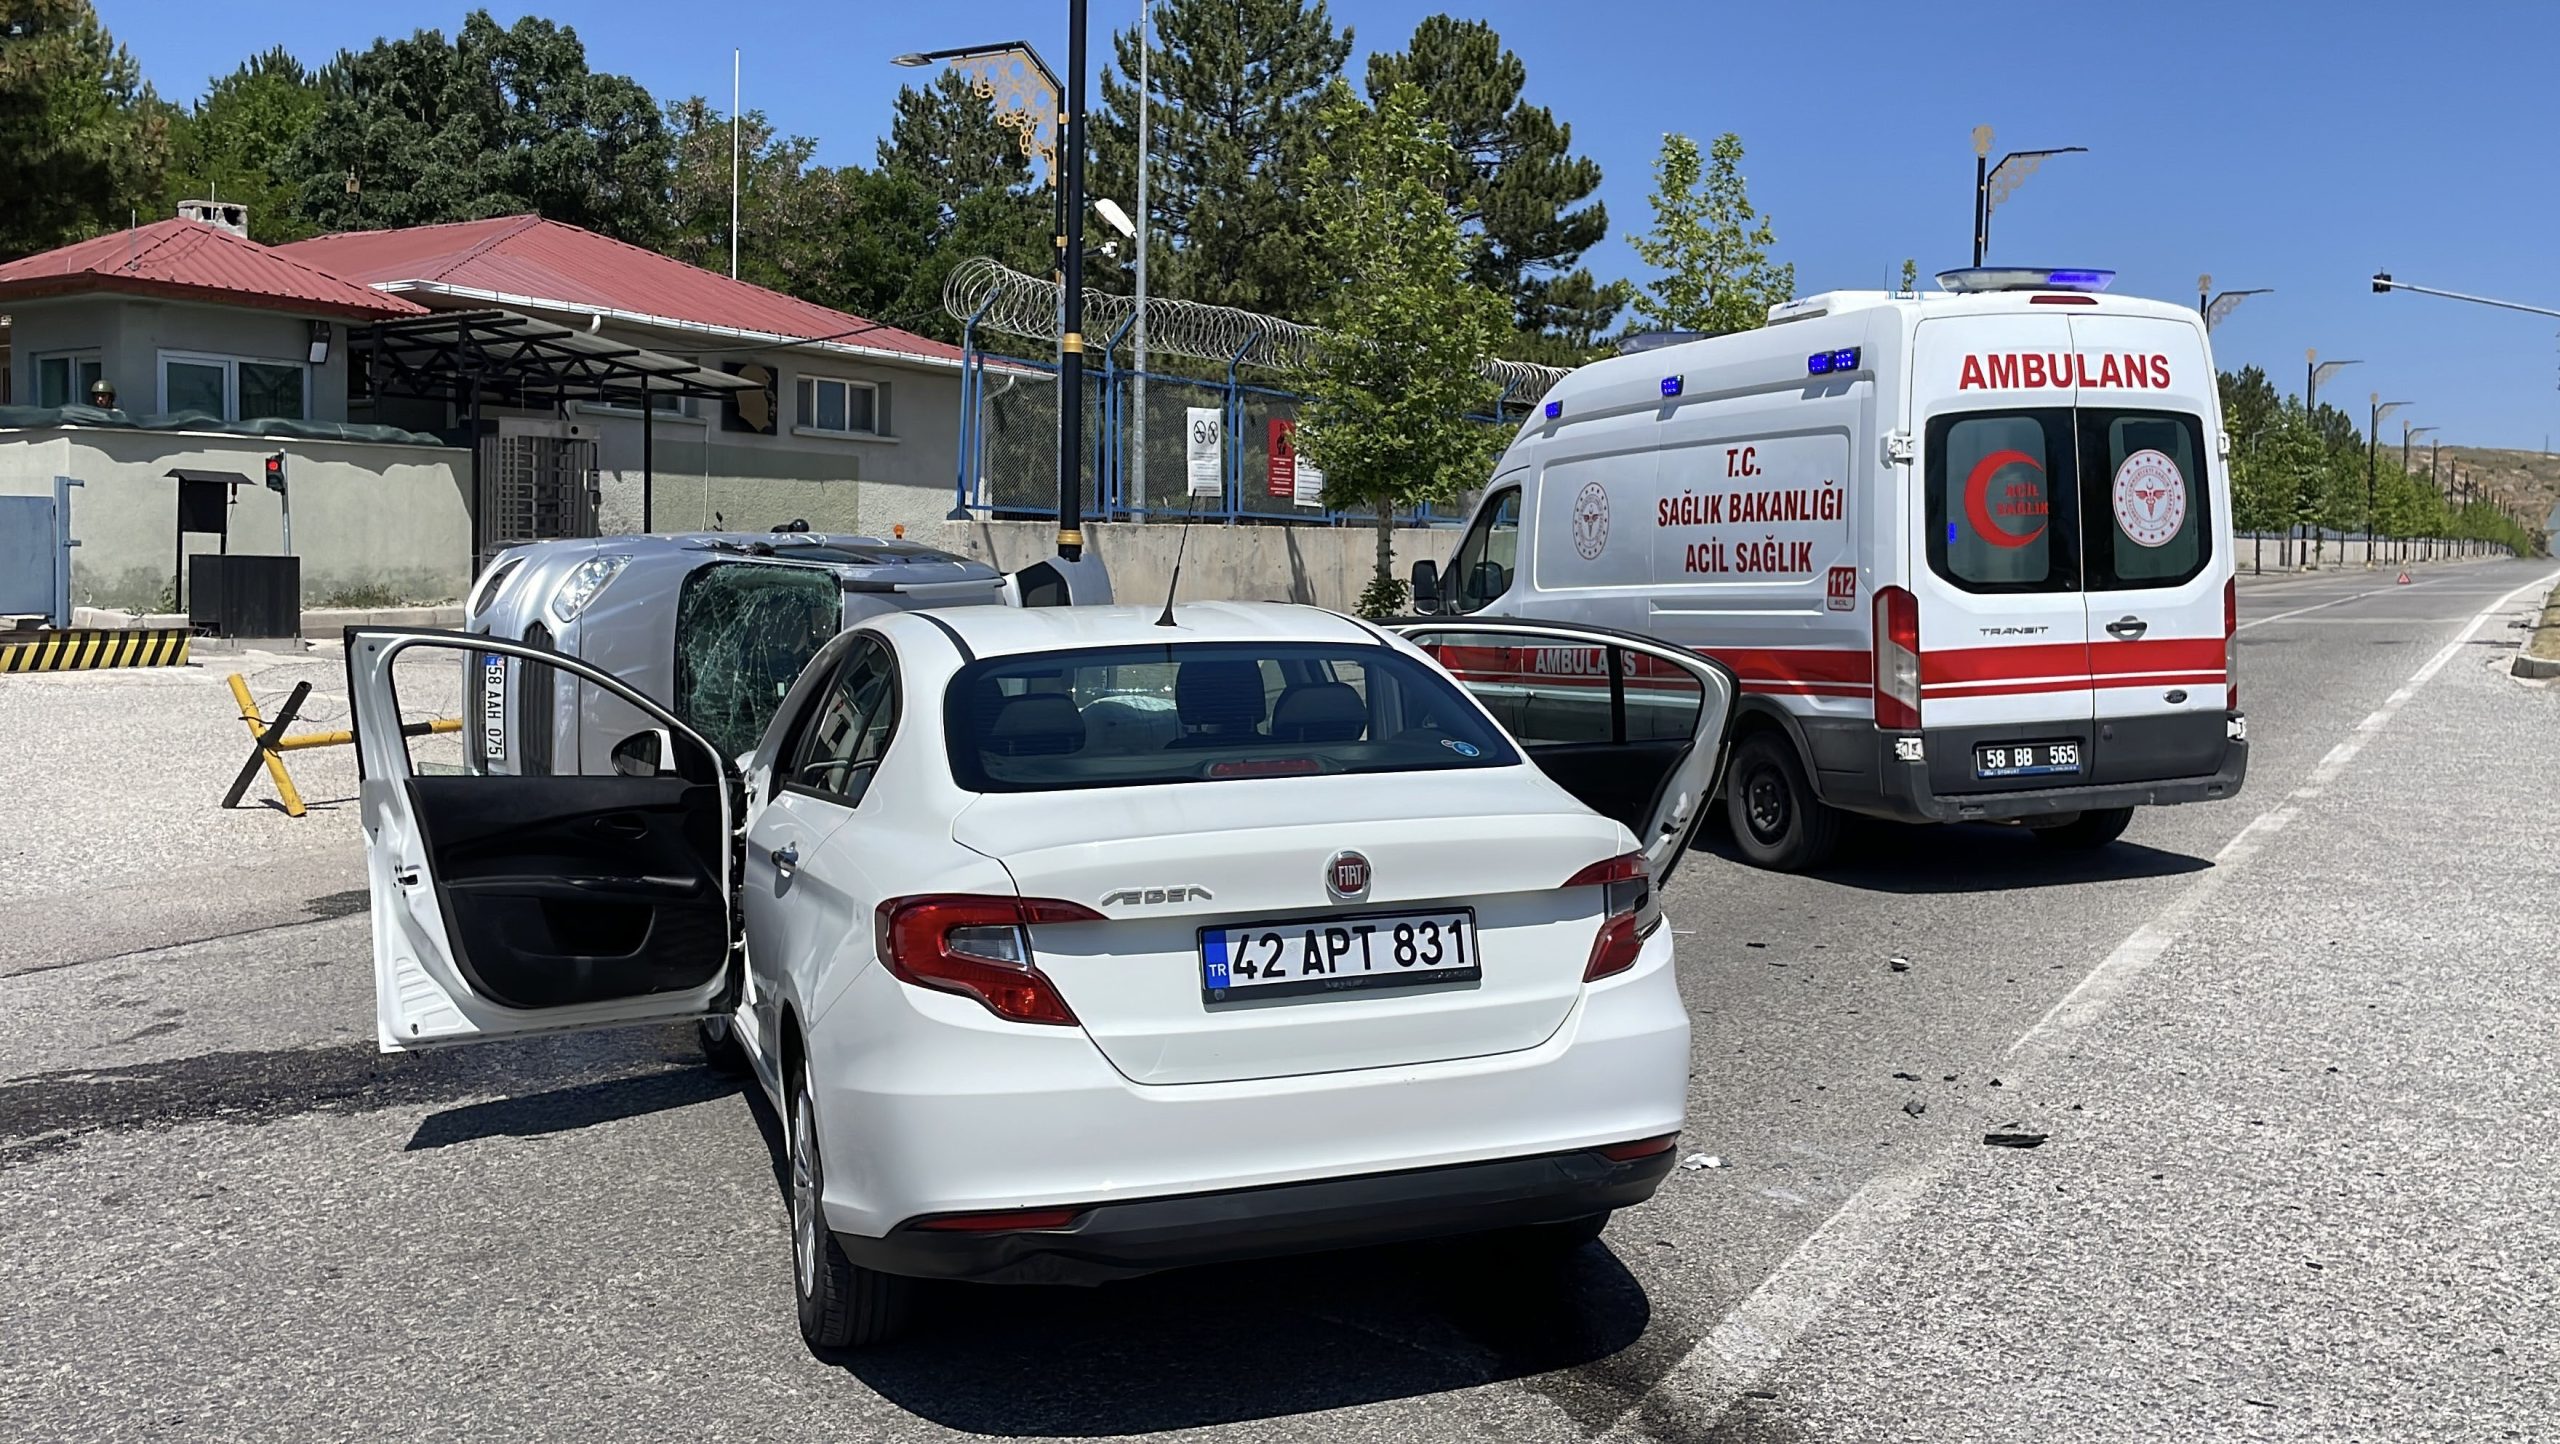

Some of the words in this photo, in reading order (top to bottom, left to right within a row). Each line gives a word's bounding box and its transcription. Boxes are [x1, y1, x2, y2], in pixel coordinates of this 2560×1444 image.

[1959, 353, 2171, 390] AMBULANS
[1726, 446, 1762, 478] T.C.
[1658, 489, 1723, 527] SAĞLIK
[1728, 479, 1844, 523] BAKANLIĞI
[1685, 536, 1729, 573] ACİL
[1735, 534, 1813, 573] SAĞLIK
[1830, 570, 1854, 595] 112
[1979, 626, 2049, 636] TRANSIT
[488, 666, 503, 685] 58
[1535, 648, 1637, 676] AMBULAS
[487, 690, 502, 719] AAH
[488, 728, 503, 756] 075
[1986, 749, 2006, 768] 58
[2014, 747, 2033, 767] BB
[2049, 744, 2076, 765] 565
[1337, 864, 1363, 886] FIAT
[1209, 963, 1227, 978] TR
[1232, 933, 1287, 979] 42
[1302, 925, 1377, 976] APT
[1393, 919, 1466, 968] 831
